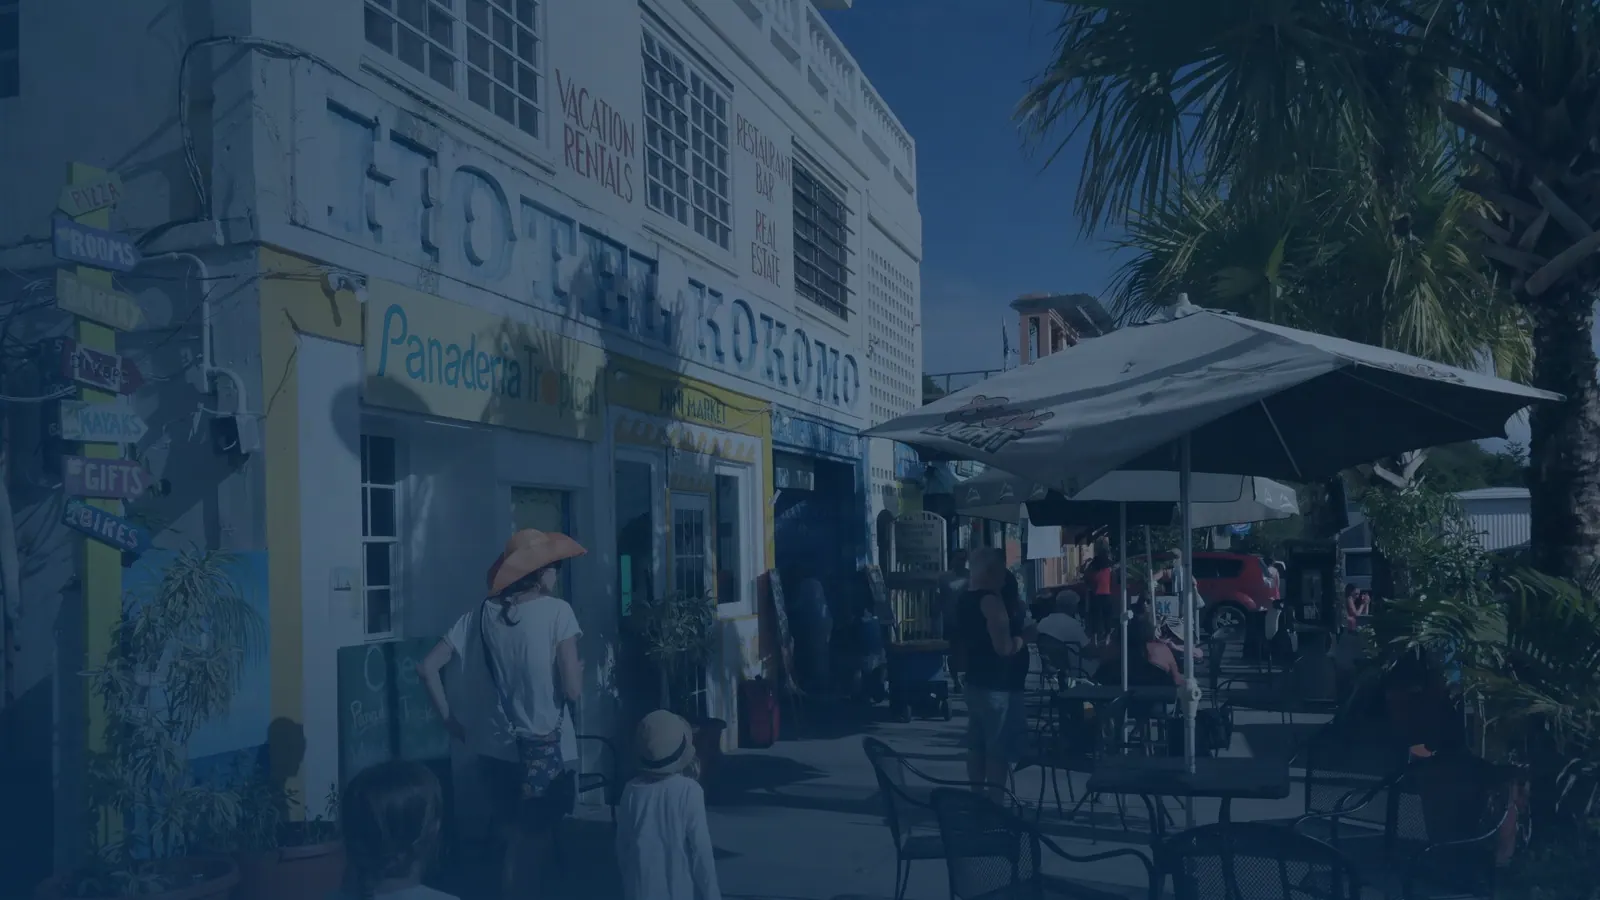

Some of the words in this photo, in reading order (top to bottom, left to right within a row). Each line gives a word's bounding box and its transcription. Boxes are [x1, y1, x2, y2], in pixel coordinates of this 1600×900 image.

[555, 67, 635, 160] VACATION
[563, 121, 634, 204] RENTALS
[736, 112, 793, 188] RESTAURANT
[755, 161, 775, 204] BAR
[69, 229, 136, 266] ROOMS
[325, 95, 673, 348] HOTEL
[687, 276, 862, 413] KOKOMO
[755, 208, 777, 254] REAL
[751, 241, 781, 288] ESTATE
[80, 409, 142, 436] KAYAKS
[84, 463, 144, 495] GIFTS
[79, 507, 140, 549] BIKES
